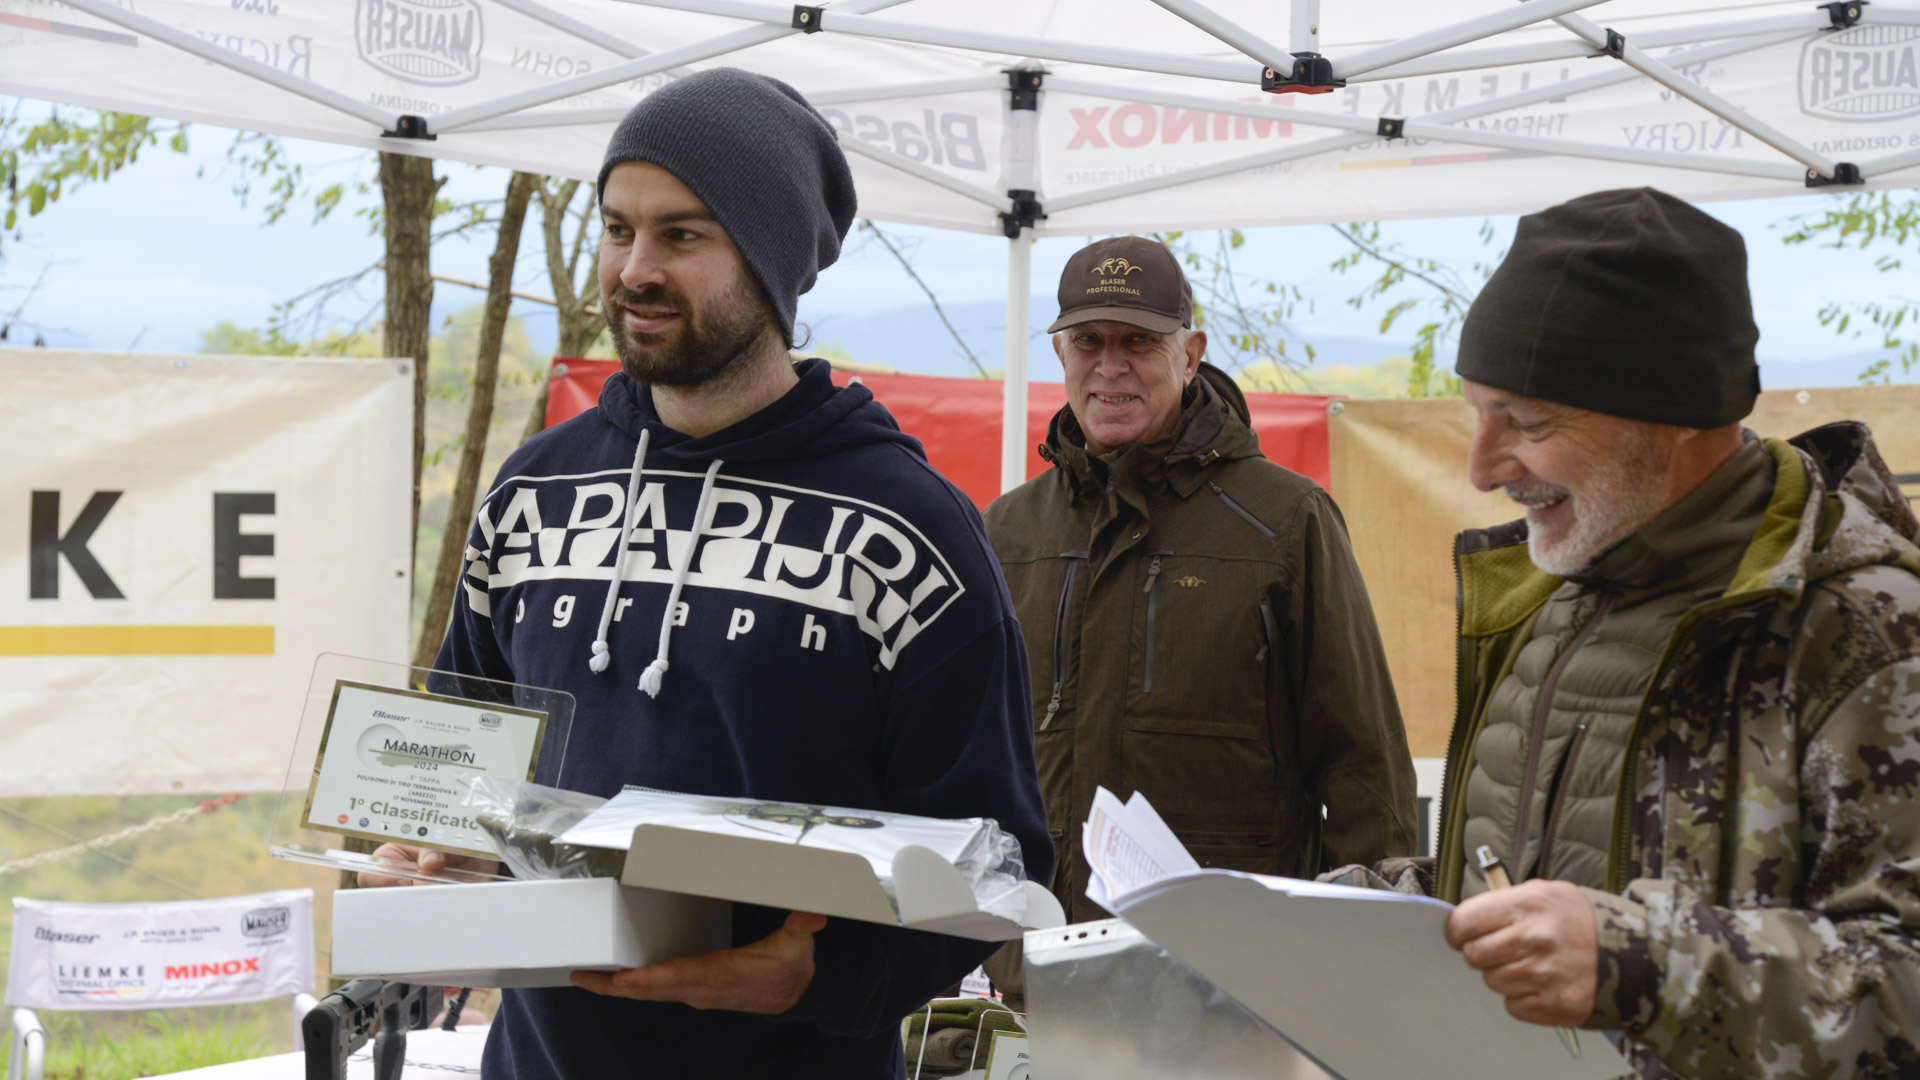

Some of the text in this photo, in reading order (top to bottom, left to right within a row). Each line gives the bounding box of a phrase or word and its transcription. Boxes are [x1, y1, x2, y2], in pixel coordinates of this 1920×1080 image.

[1100, 278, 1126, 286] BLASER
[1086, 285, 1141, 296] PROFESSIONAL
[372, 709, 410, 723] Blaser
[384, 738, 476, 764] MARATHON
[413, 760, 439, 771] 2024
[356, 774, 389, 785] POLIGONO
[397, 780, 412, 788] TIRO
[412, 782, 452, 796] TERRANUOVA
[418, 775, 441, 785] TAPPA
[408, 790, 437, 801] (AREZZO)
[400, 796, 433, 807] NOVEMBRE
[434, 801, 449, 809] 2024
[34, 926, 101, 945] Blaser
[58, 964, 146, 978] LIEMKE
[164, 957, 261, 980] MINOX
[58, 978, 146, 989] THERMAL OPTICS
